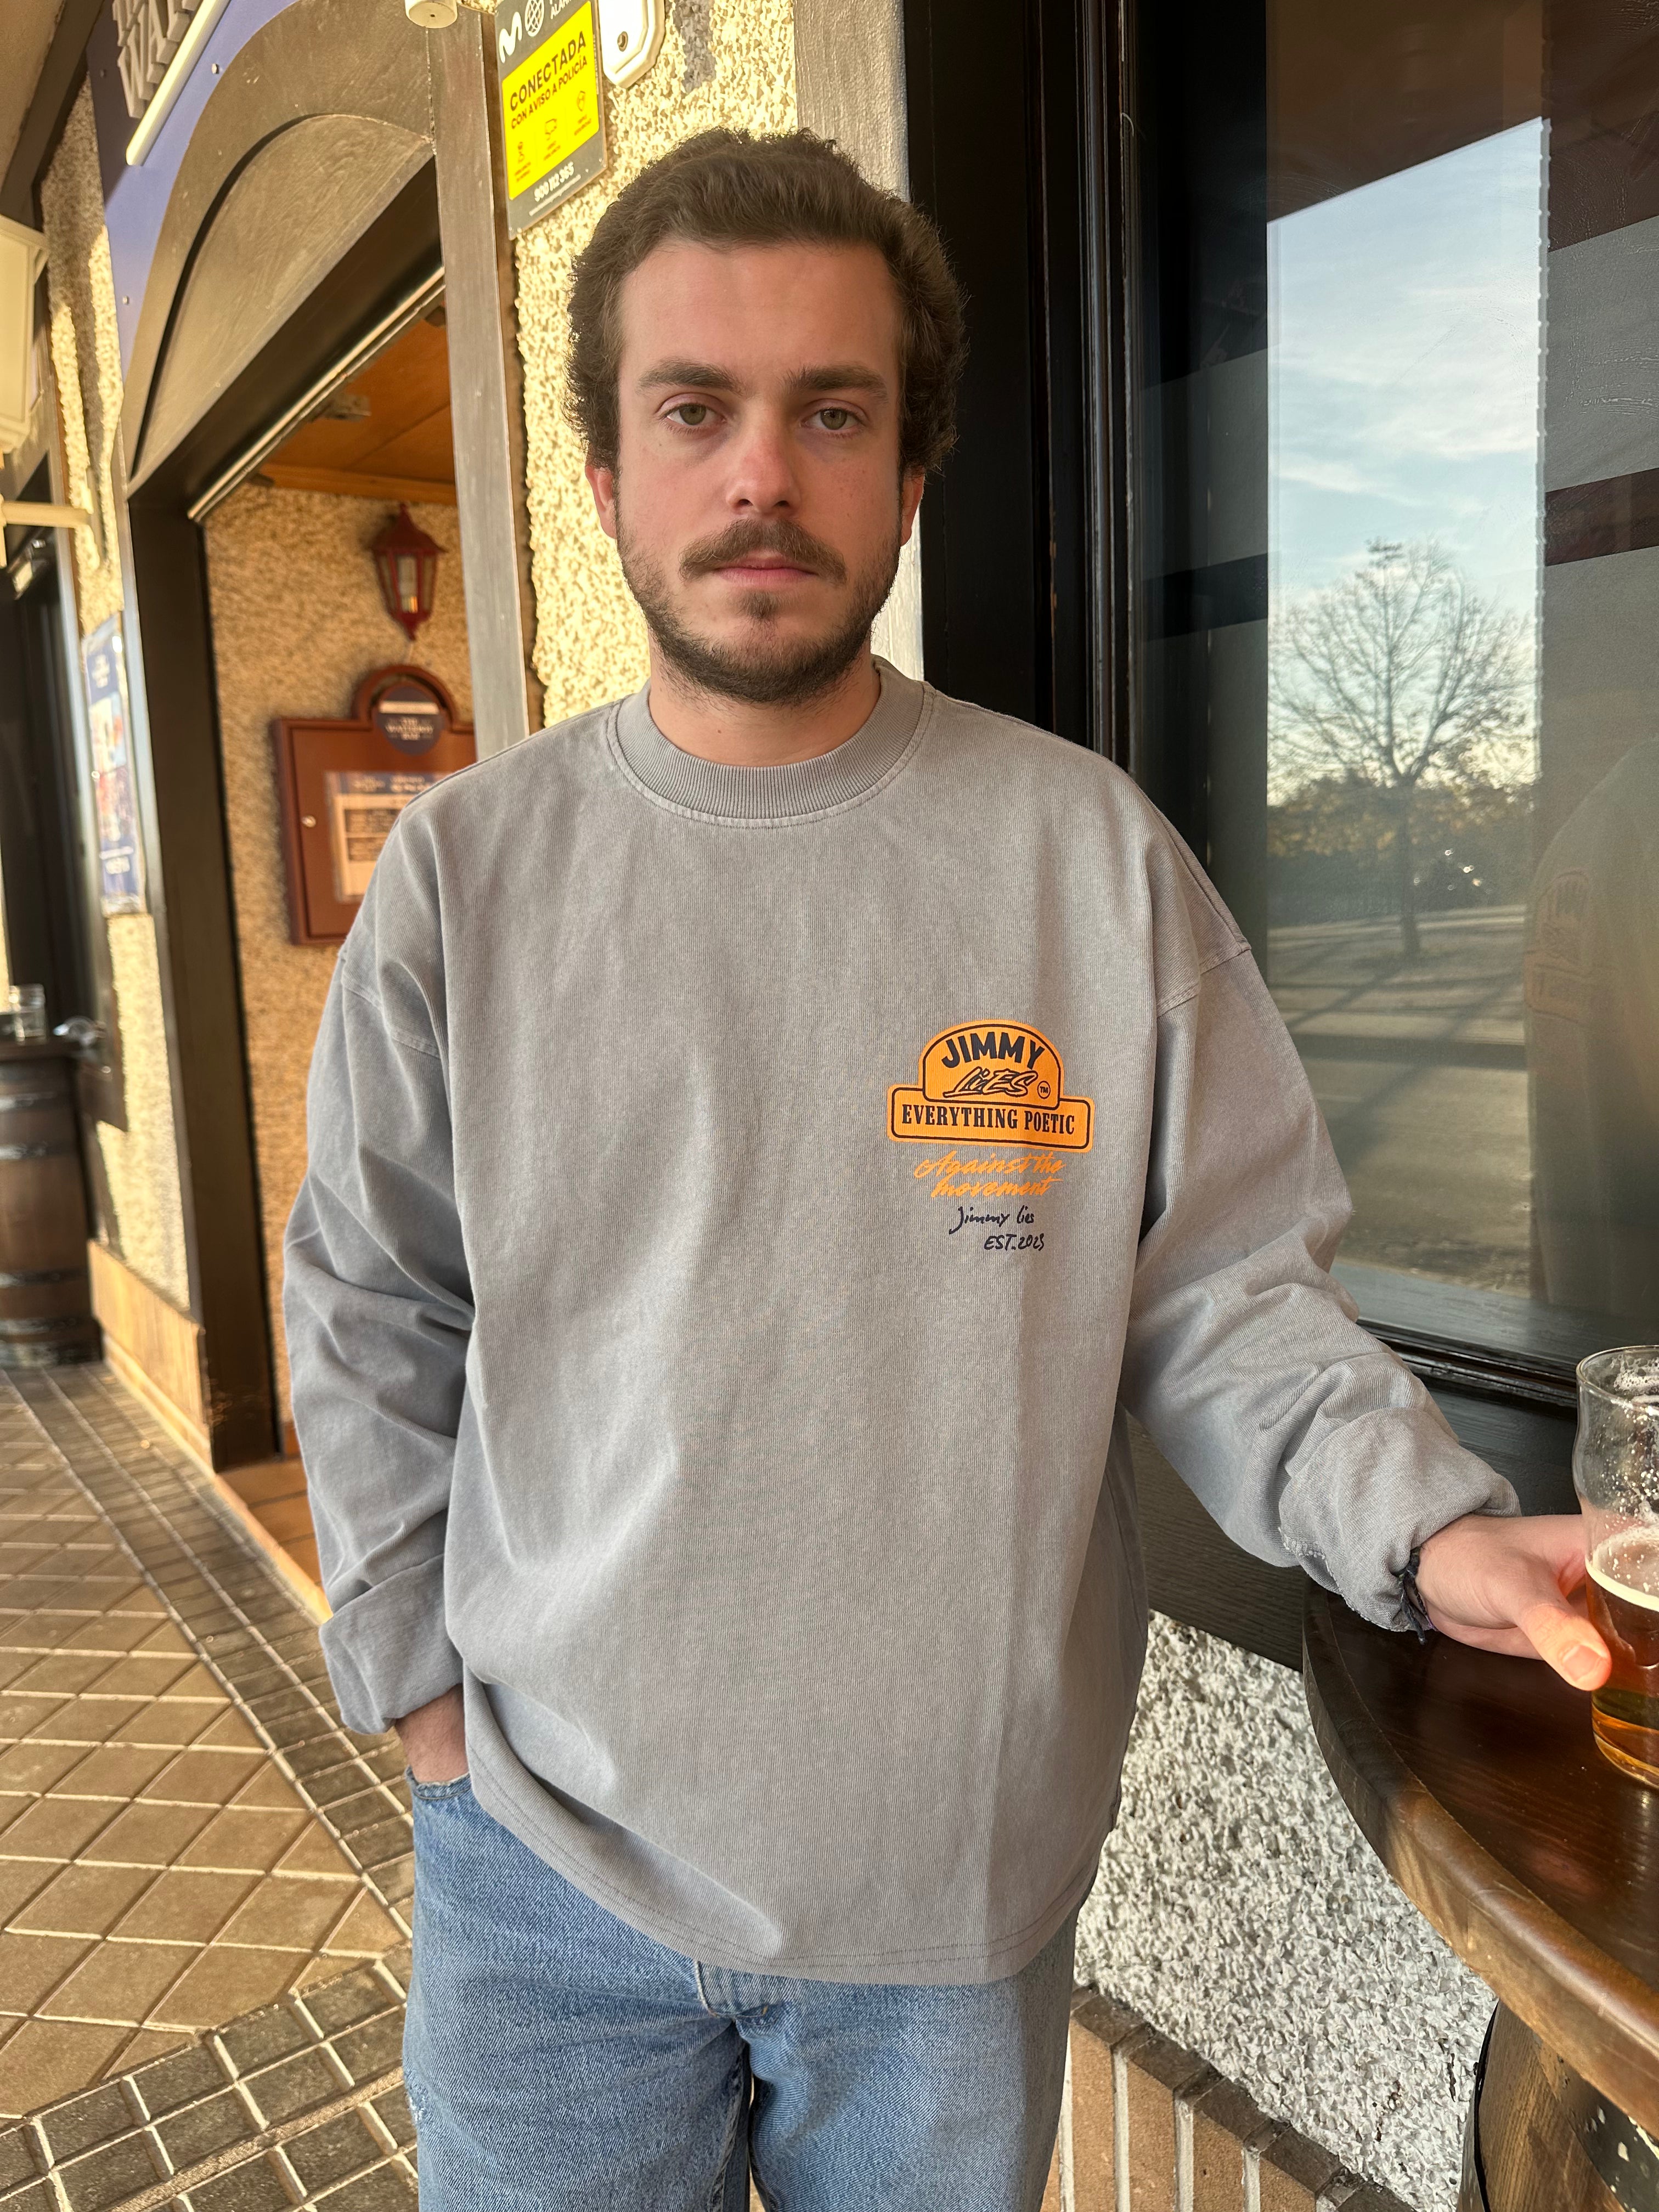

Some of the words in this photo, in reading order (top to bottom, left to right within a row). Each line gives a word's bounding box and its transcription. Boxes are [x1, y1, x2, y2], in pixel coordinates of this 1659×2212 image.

[510, 31, 586, 111] CONECTADA
[511, 108, 527, 129] CON
[529, 88, 551, 116] AVISO
[552, 83, 557, 96] A
[558, 55, 588, 89] POLICÍA
[941, 1031, 1045, 1070] JIMMY
[901, 1104, 1018, 1129] EVERYTHING
[1024, 1110, 1075, 1135] POETIC
[913, 1150, 1031, 1179] Against
[1031, 1151, 1066, 1174] the
[930, 1175, 1064, 1198] movement
[948, 1206, 1011, 1235] Jimmy
